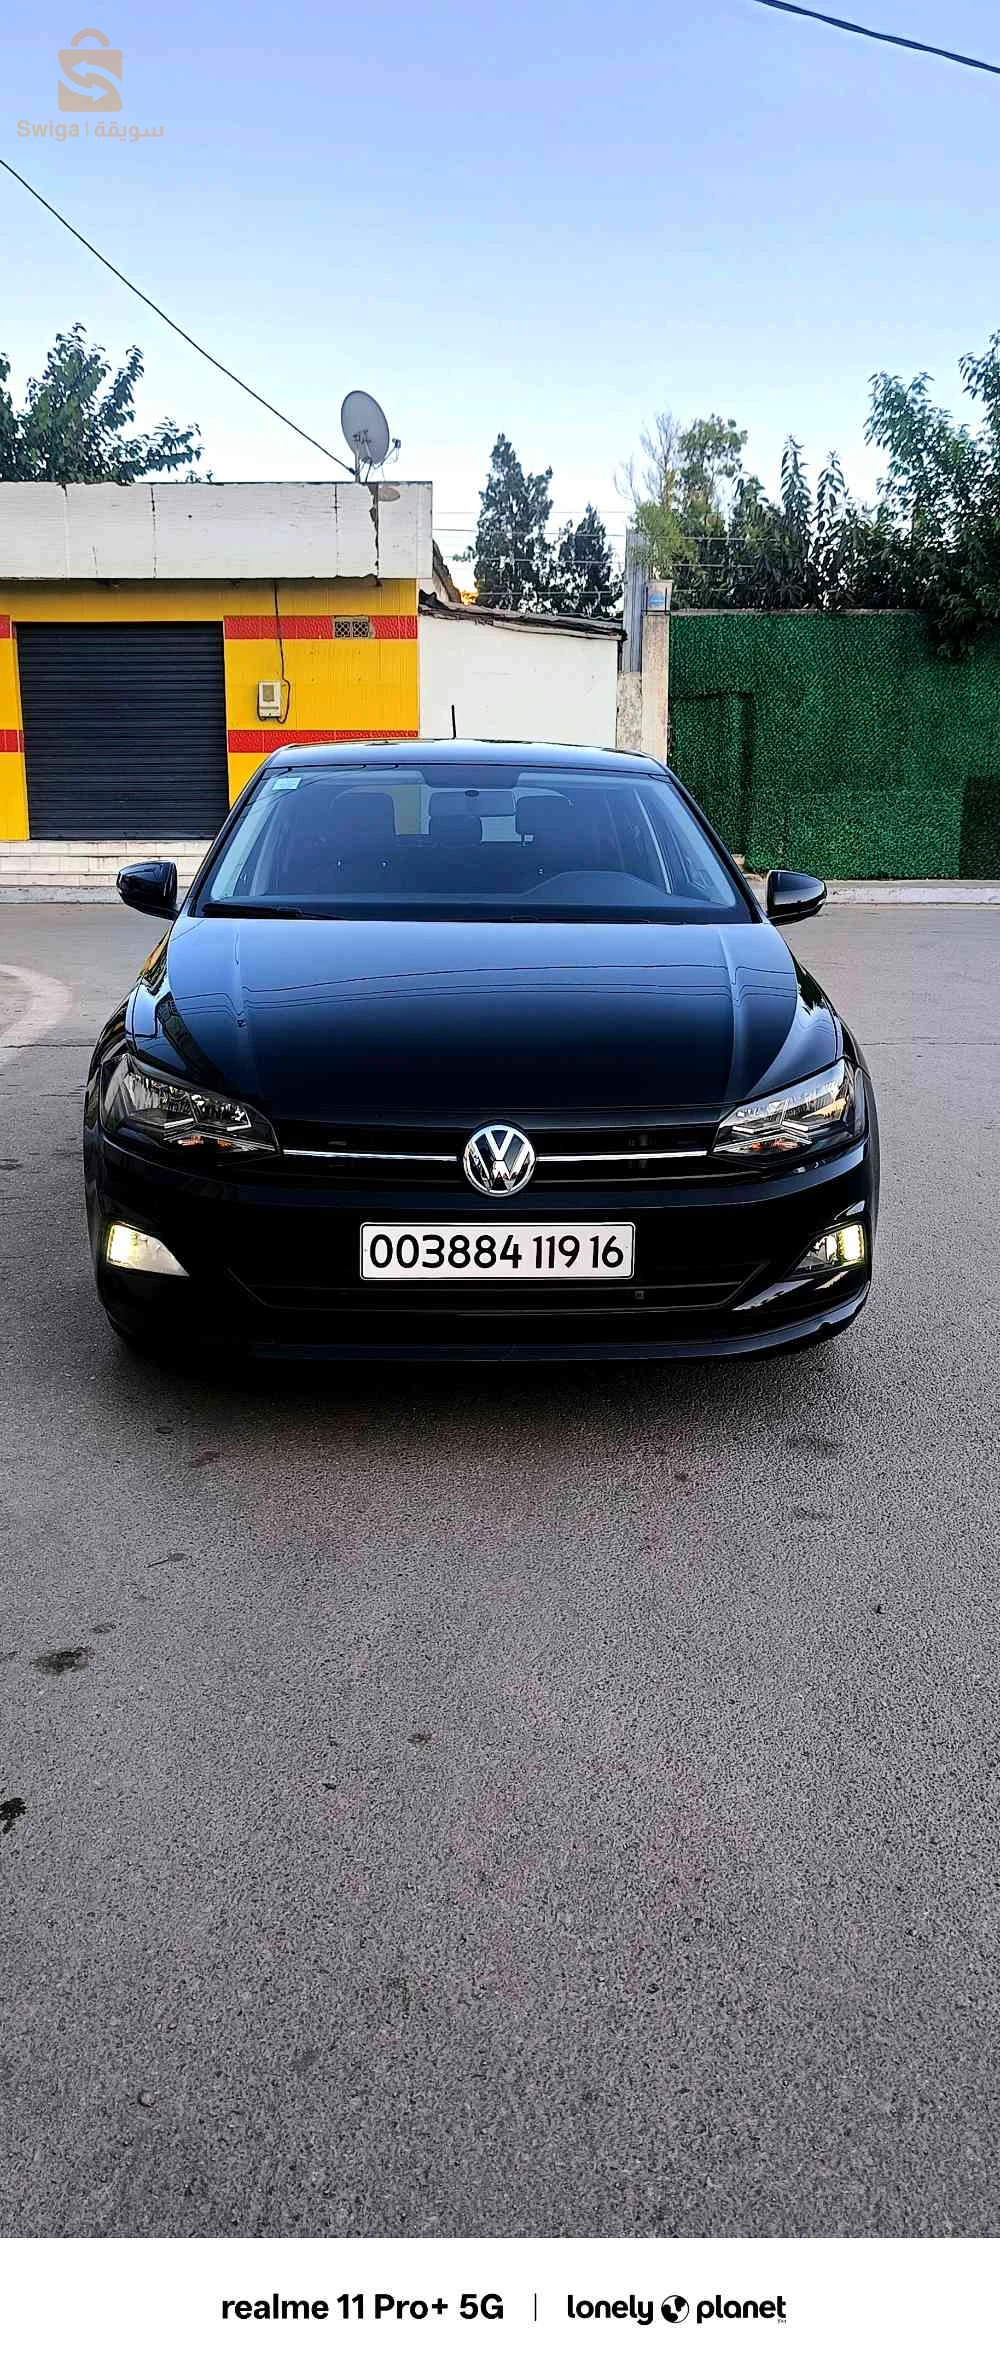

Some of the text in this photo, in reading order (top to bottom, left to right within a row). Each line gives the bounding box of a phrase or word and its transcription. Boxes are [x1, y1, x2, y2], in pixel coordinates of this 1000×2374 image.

[369, 1233, 624, 1269] 003884 119 16
